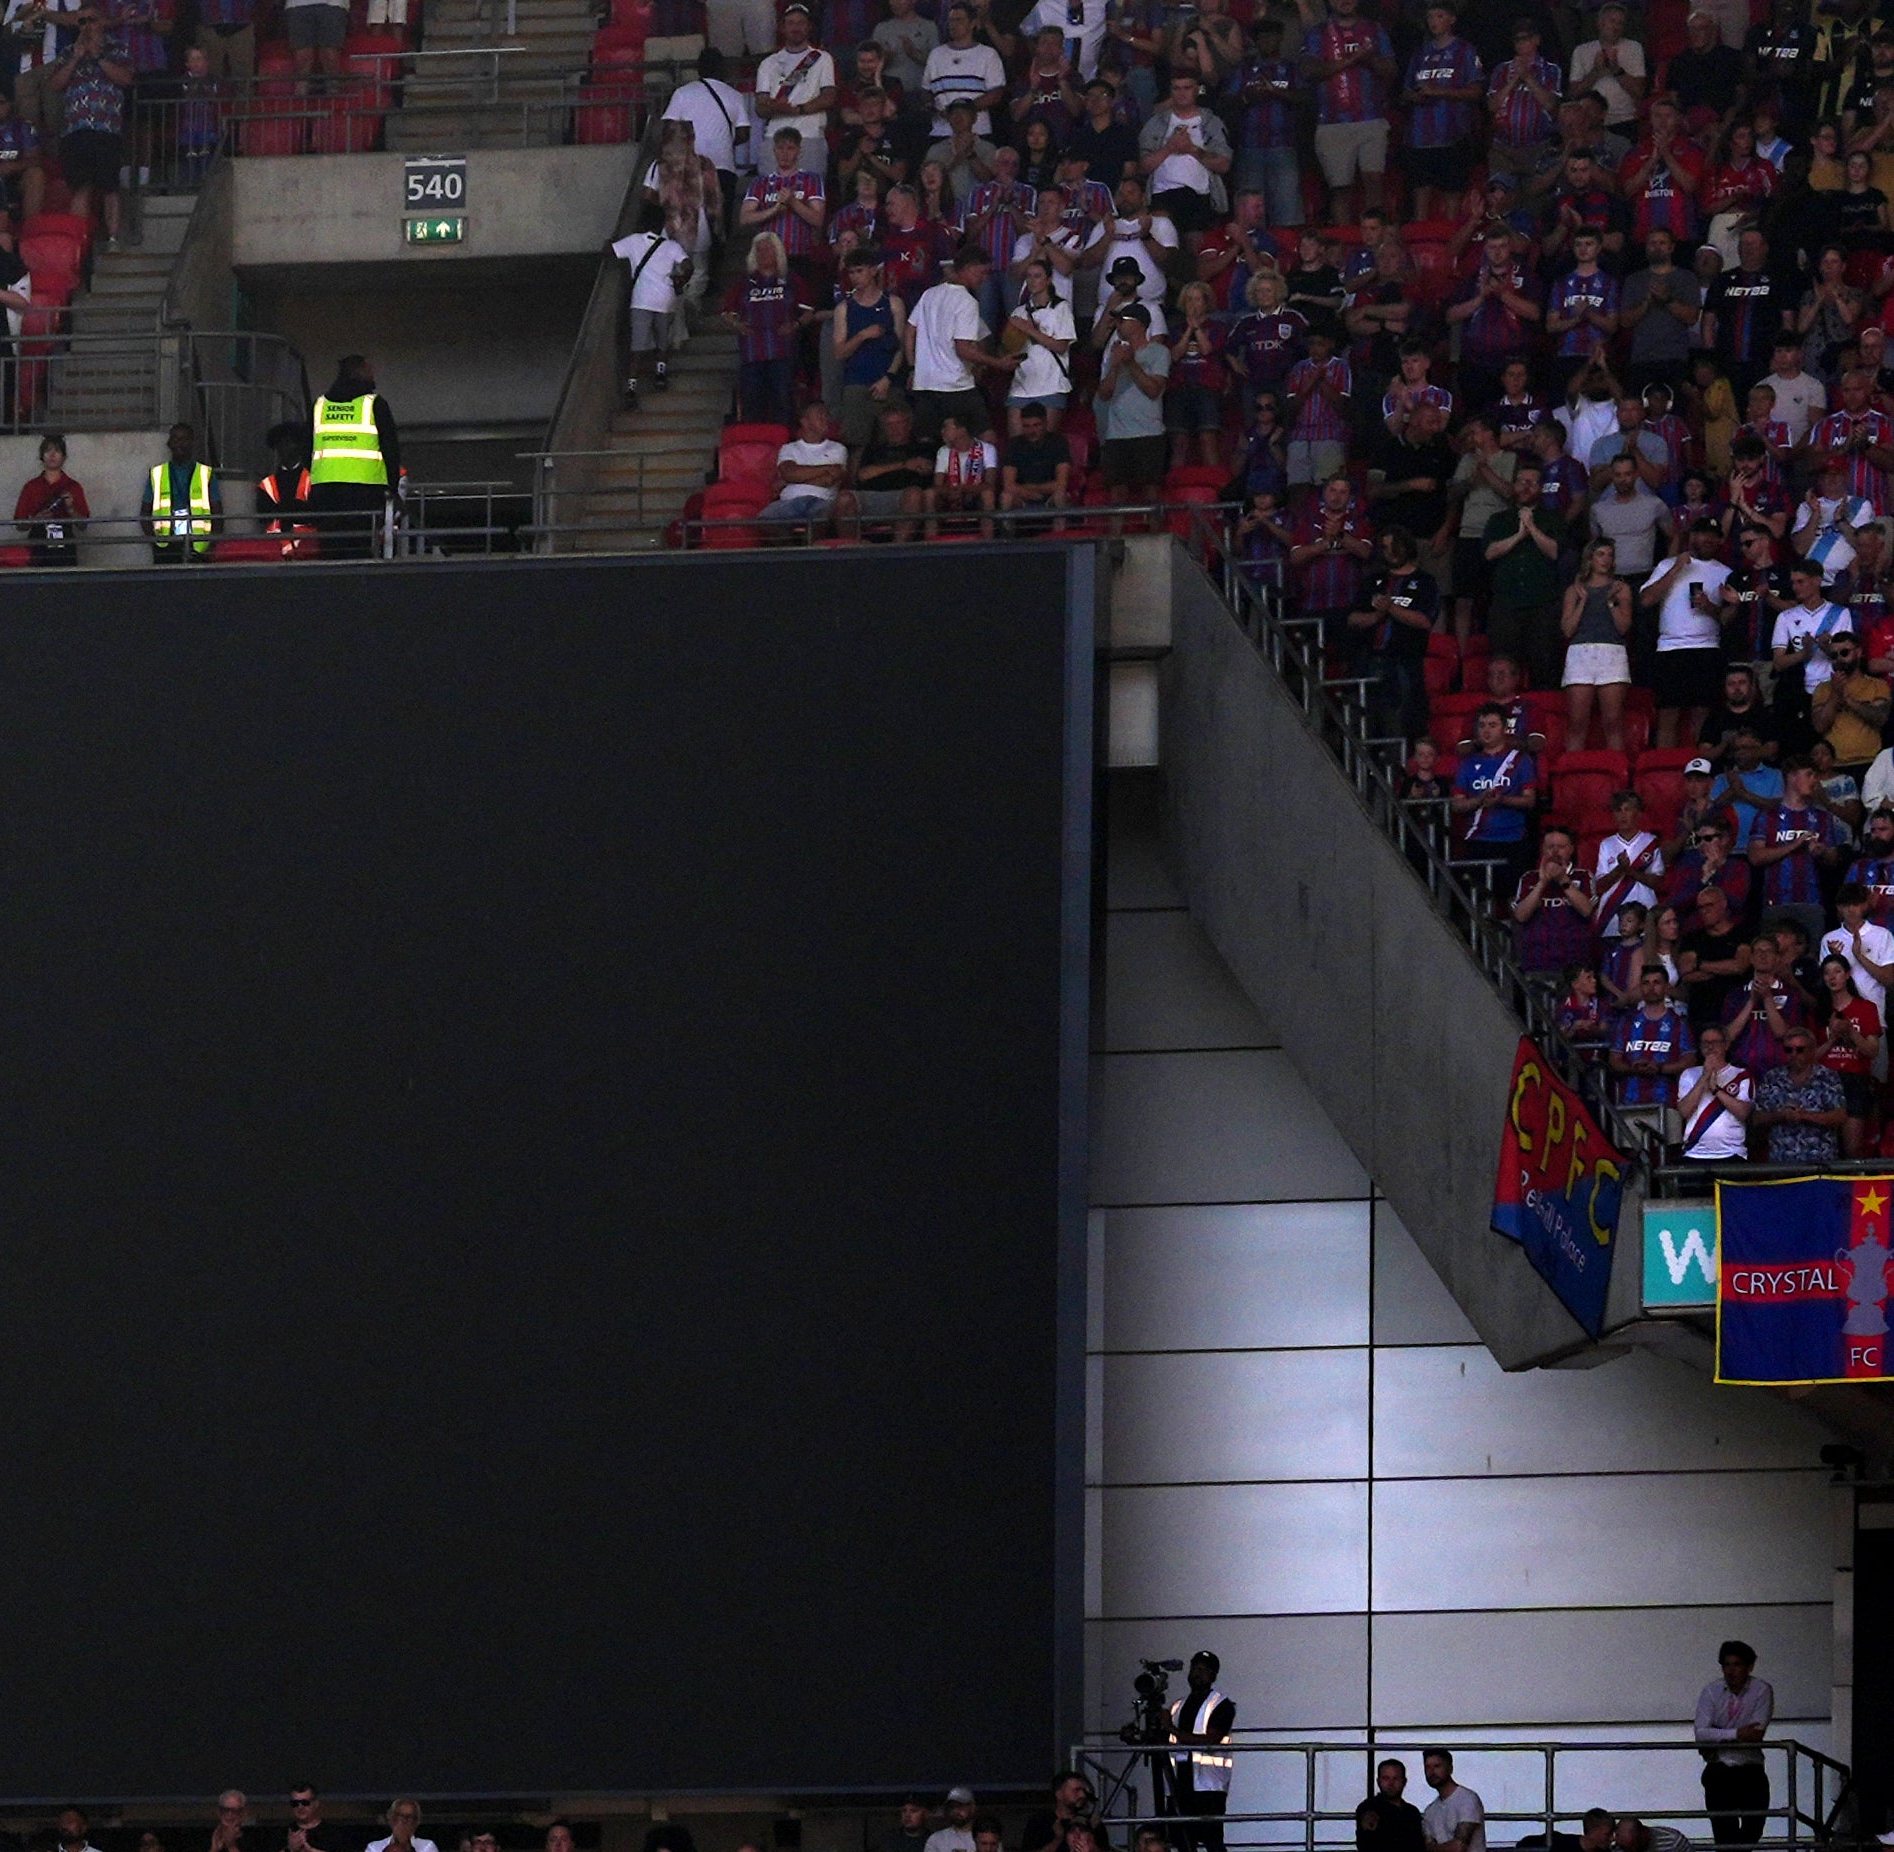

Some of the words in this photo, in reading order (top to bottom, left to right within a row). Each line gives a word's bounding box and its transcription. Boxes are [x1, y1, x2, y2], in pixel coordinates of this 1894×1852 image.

[407, 175, 462, 200] 540
[1724, 285, 1771, 297] NET88
[1625, 1039, 1672, 1053] NET88
[1732, 1268, 1839, 1295] CRYSTAL
[1851, 1347, 1878, 1367] FC
